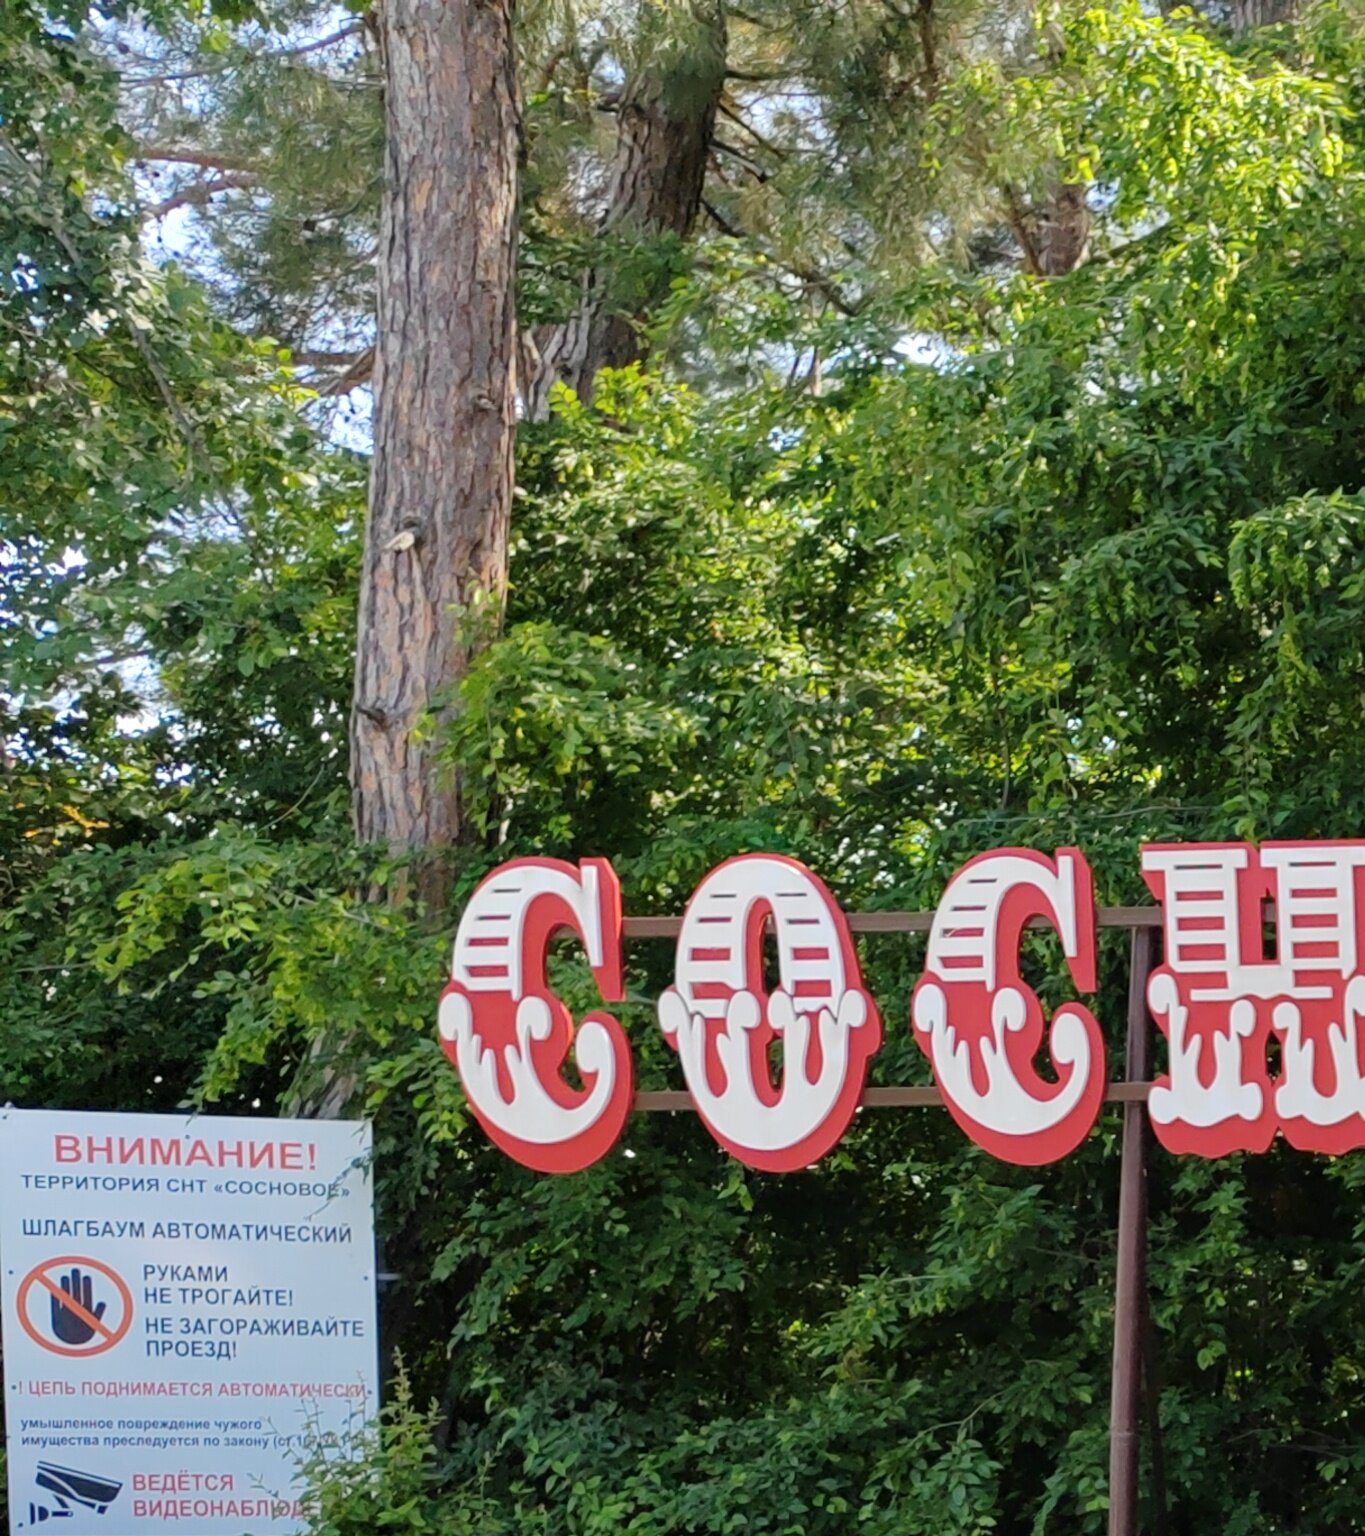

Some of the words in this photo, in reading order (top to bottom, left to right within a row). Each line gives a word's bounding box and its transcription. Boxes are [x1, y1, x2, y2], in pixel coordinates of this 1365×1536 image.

[54, 1134, 317, 1170] ВНИМАНИЕ!
[20, 1174, 159, 1193] ТЕРРИТОРИЯ
[166, 1179, 206, 1194] СНТ
[22, 1218, 146, 1239] ШЛАГБАУМ
[152, 1221, 353, 1244] АВТОМАТИЧЕСКИЙ
[143, 1264, 229, 1283] РУКАМИ
[144, 1288, 172, 1304] НЕ
[178, 1286, 294, 1307] ТРОГАЙТЕ!
[146, 1317, 173, 1334] НЕ
[179, 1316, 365, 1338] ЗАГОРАЖИВАЙТЕ
[147, 1340, 237, 1361] ПРОЕЗД!
[28, 1381, 76, 1399] ЦЕПЬ
[81, 1381, 213, 1398] ПОДНИМАЕТСЯ
[20, 1416, 114, 1432] умышленное
[117, 1418, 210, 1433] повреждение
[214, 1420, 262, 1433] чужого
[21, 1435, 99, 1449] имущества
[102, 1436, 199, 1449] преследуется
[203, 1437, 220, 1447] по
[224, 1438, 270, 1450] закону
[132, 1471, 234, 1493] ВЕДЁТСЯ
